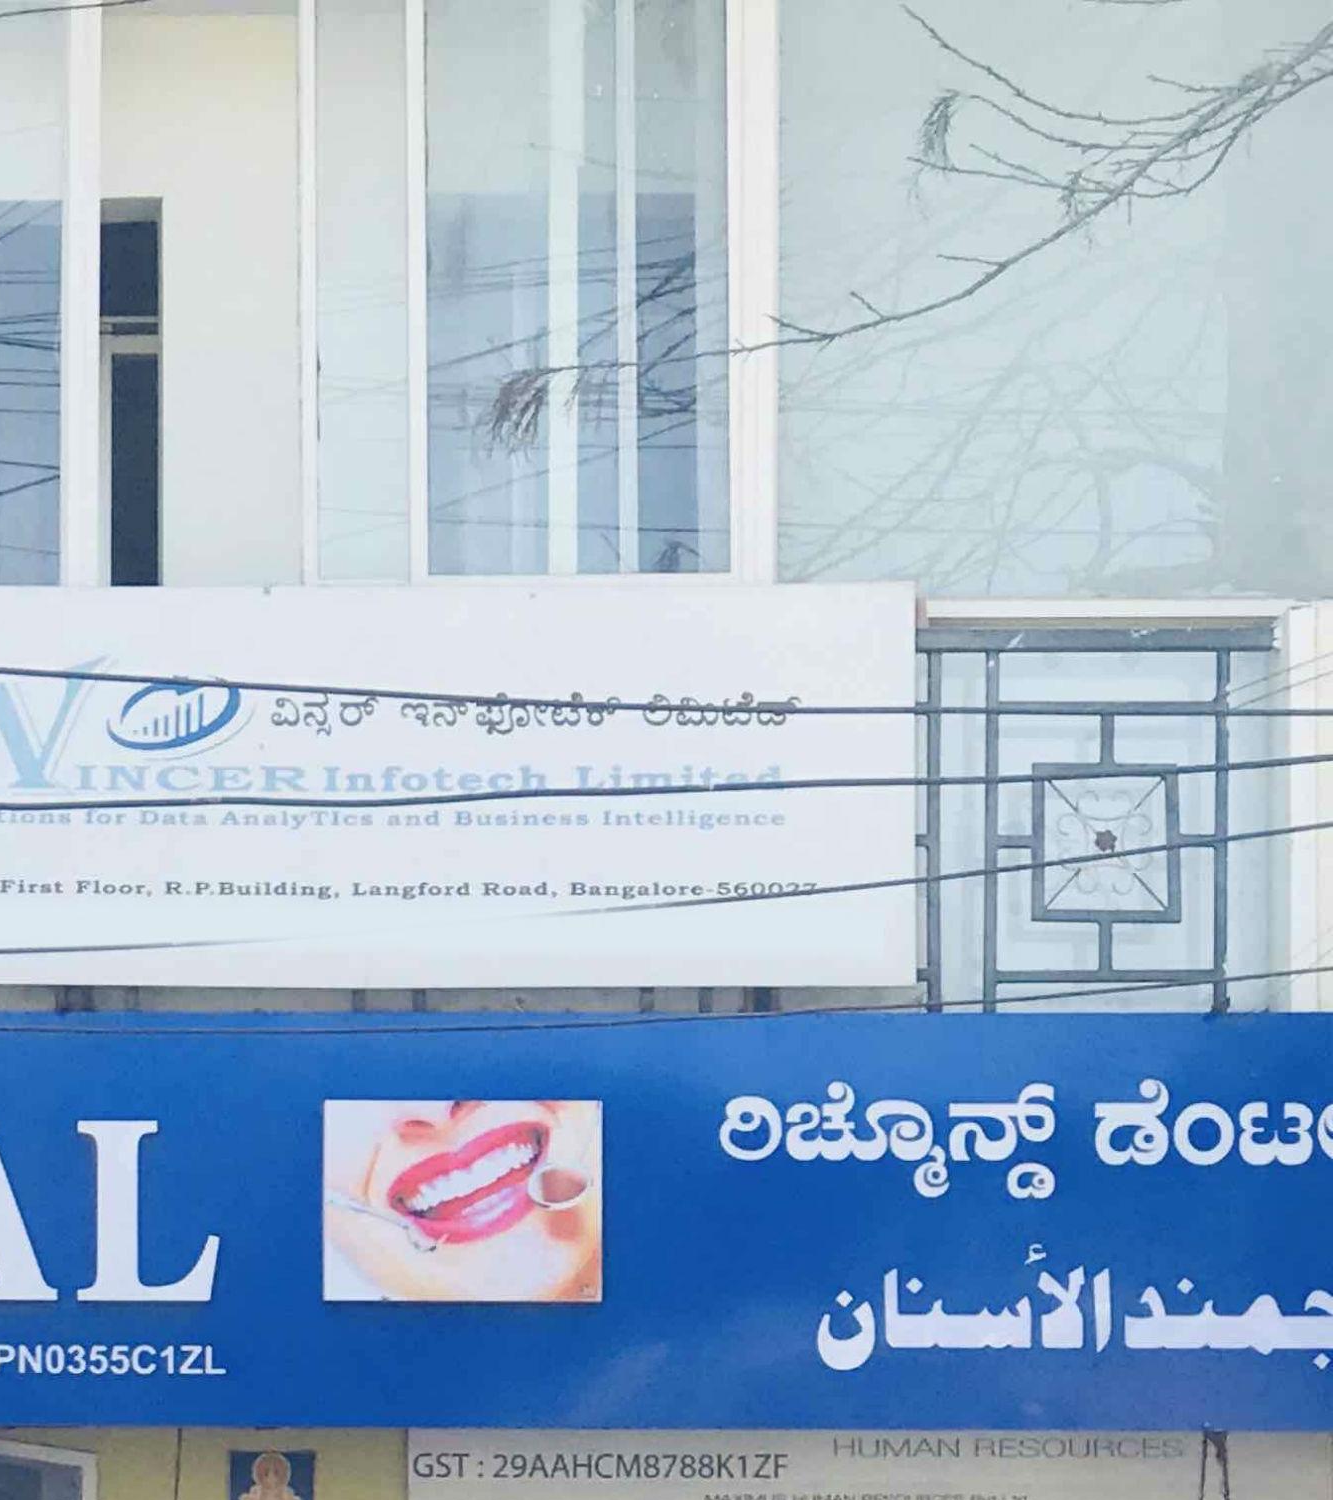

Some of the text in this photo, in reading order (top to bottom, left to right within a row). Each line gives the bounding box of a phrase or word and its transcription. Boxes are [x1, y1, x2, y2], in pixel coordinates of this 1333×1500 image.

[323, 766, 782, 794] Infotech Limited
[85, 808, 126, 826] for
[138, 808, 207, 827] Data
[387, 810, 441, 828] and
[454, 809, 591, 828] Business
[602, 809, 787, 831] Intelligence
[0, 879, 64, 894] First
[76, 880, 154, 896] Floor,
[351, 881, 470, 899] Langford
[482, 881, 560, 898] Road,
[833, 1437, 1186, 1459] HUMAN RESOURCES
[412, 1453, 789, 1480] GST 29AAHCM8788K1ZF
